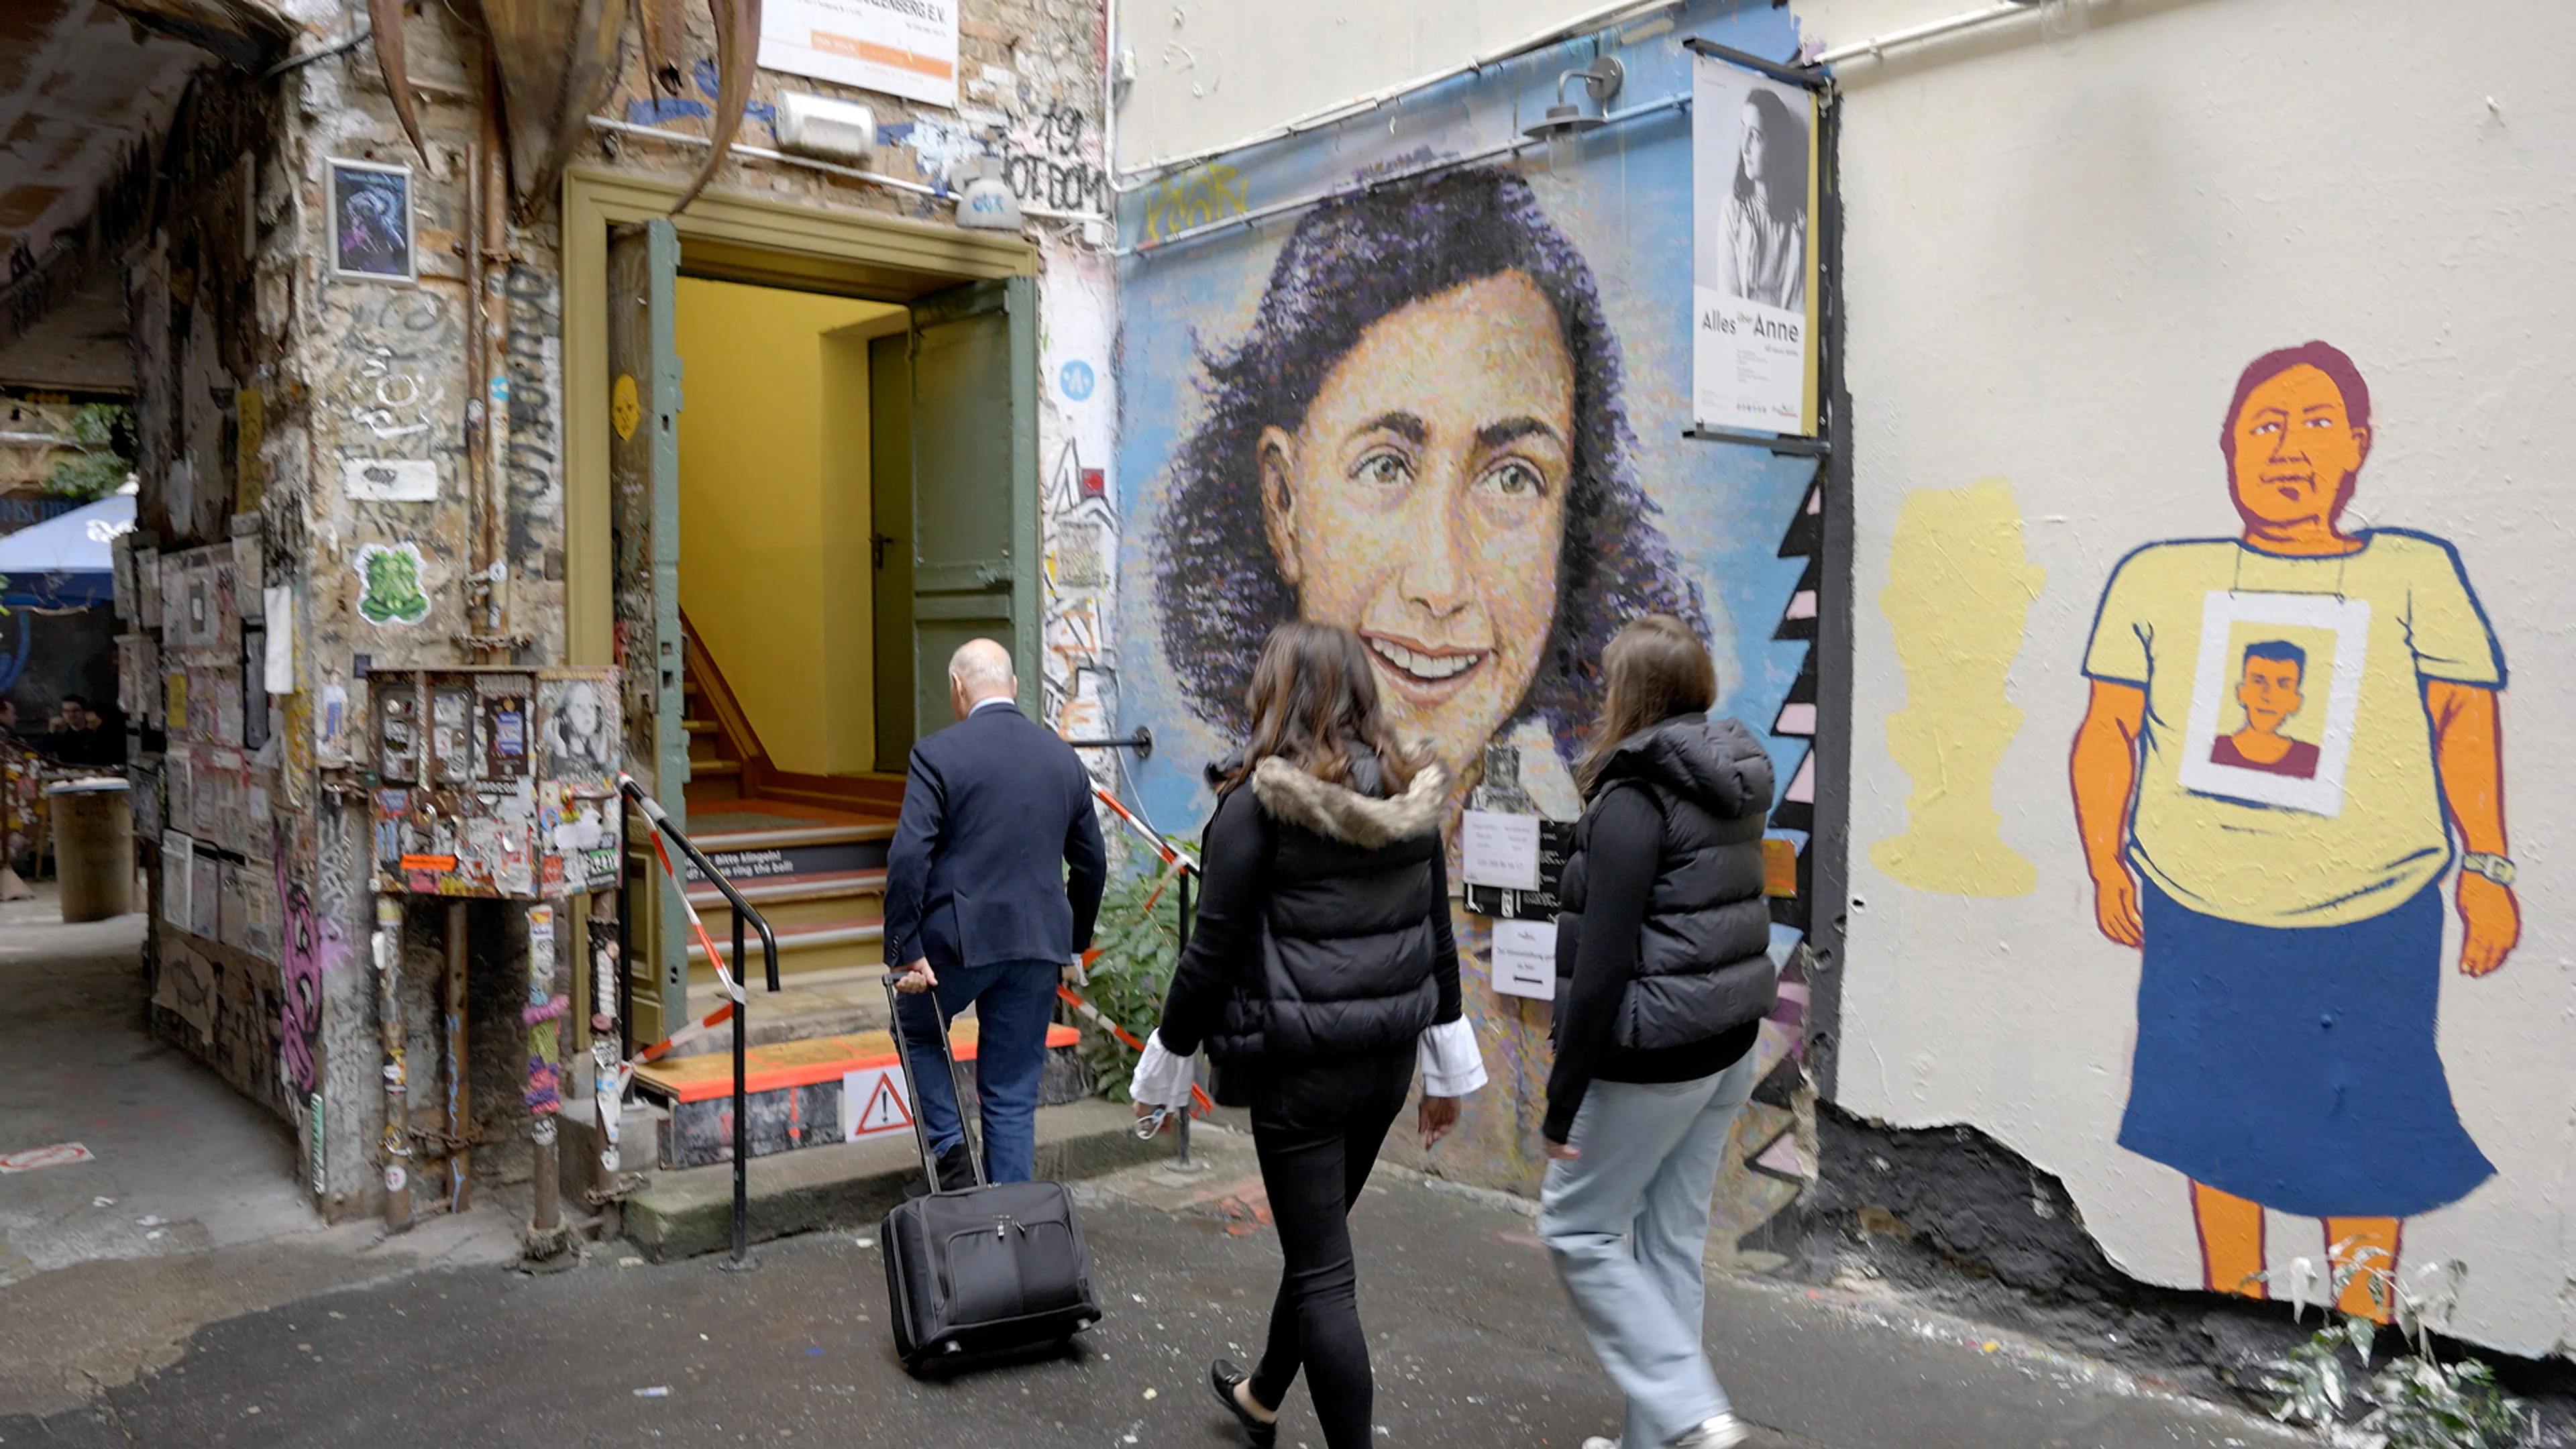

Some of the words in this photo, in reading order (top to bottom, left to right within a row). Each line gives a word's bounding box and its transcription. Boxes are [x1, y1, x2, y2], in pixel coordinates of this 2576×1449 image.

[1702, 308, 1737, 335] Alles
[1754, 312, 1799, 343] Anne
[733, 865, 753, 877] ring
[753, 863, 771, 875] the
